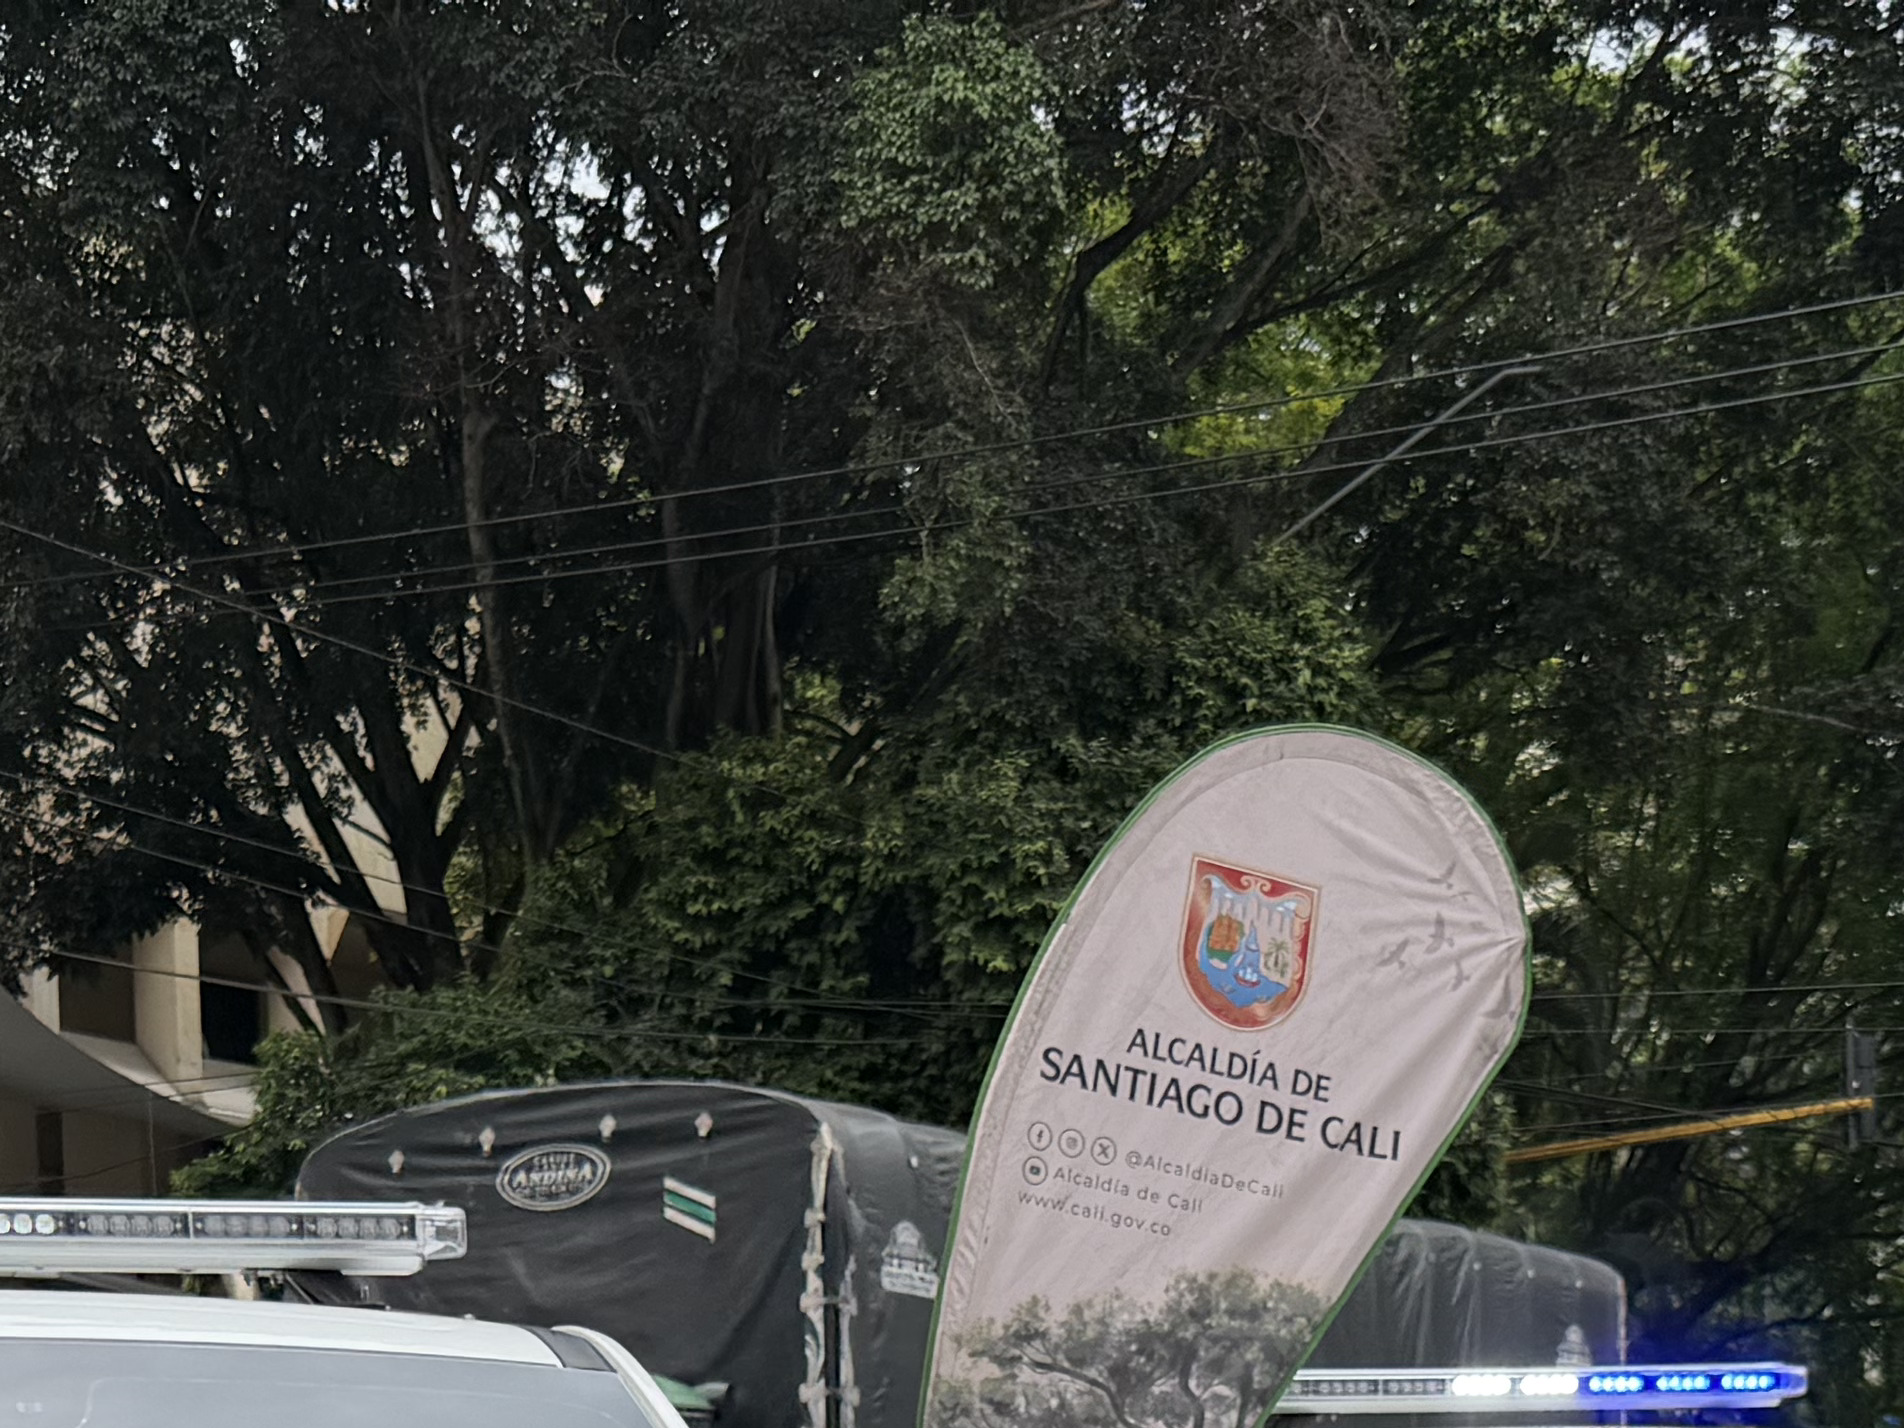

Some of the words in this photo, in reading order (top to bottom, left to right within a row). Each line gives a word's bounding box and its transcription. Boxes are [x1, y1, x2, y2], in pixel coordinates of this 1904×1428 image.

[1126, 1029, 1279, 1091] ALCALDÍA
[1291, 1069, 1331, 1102] DE
[1040, 1047, 1243, 1125] SANTIAGO
[1256, 1100, 1307, 1142] DE
[1320, 1116, 1401, 1161] CALI
[1017, 1190, 1171, 1237] www.cali.gov.co
[1053, 1167, 1129, 1198] Alcaldía
[1137, 1182, 1160, 1204] de
[1167, 1191, 1203, 1214] Cali
